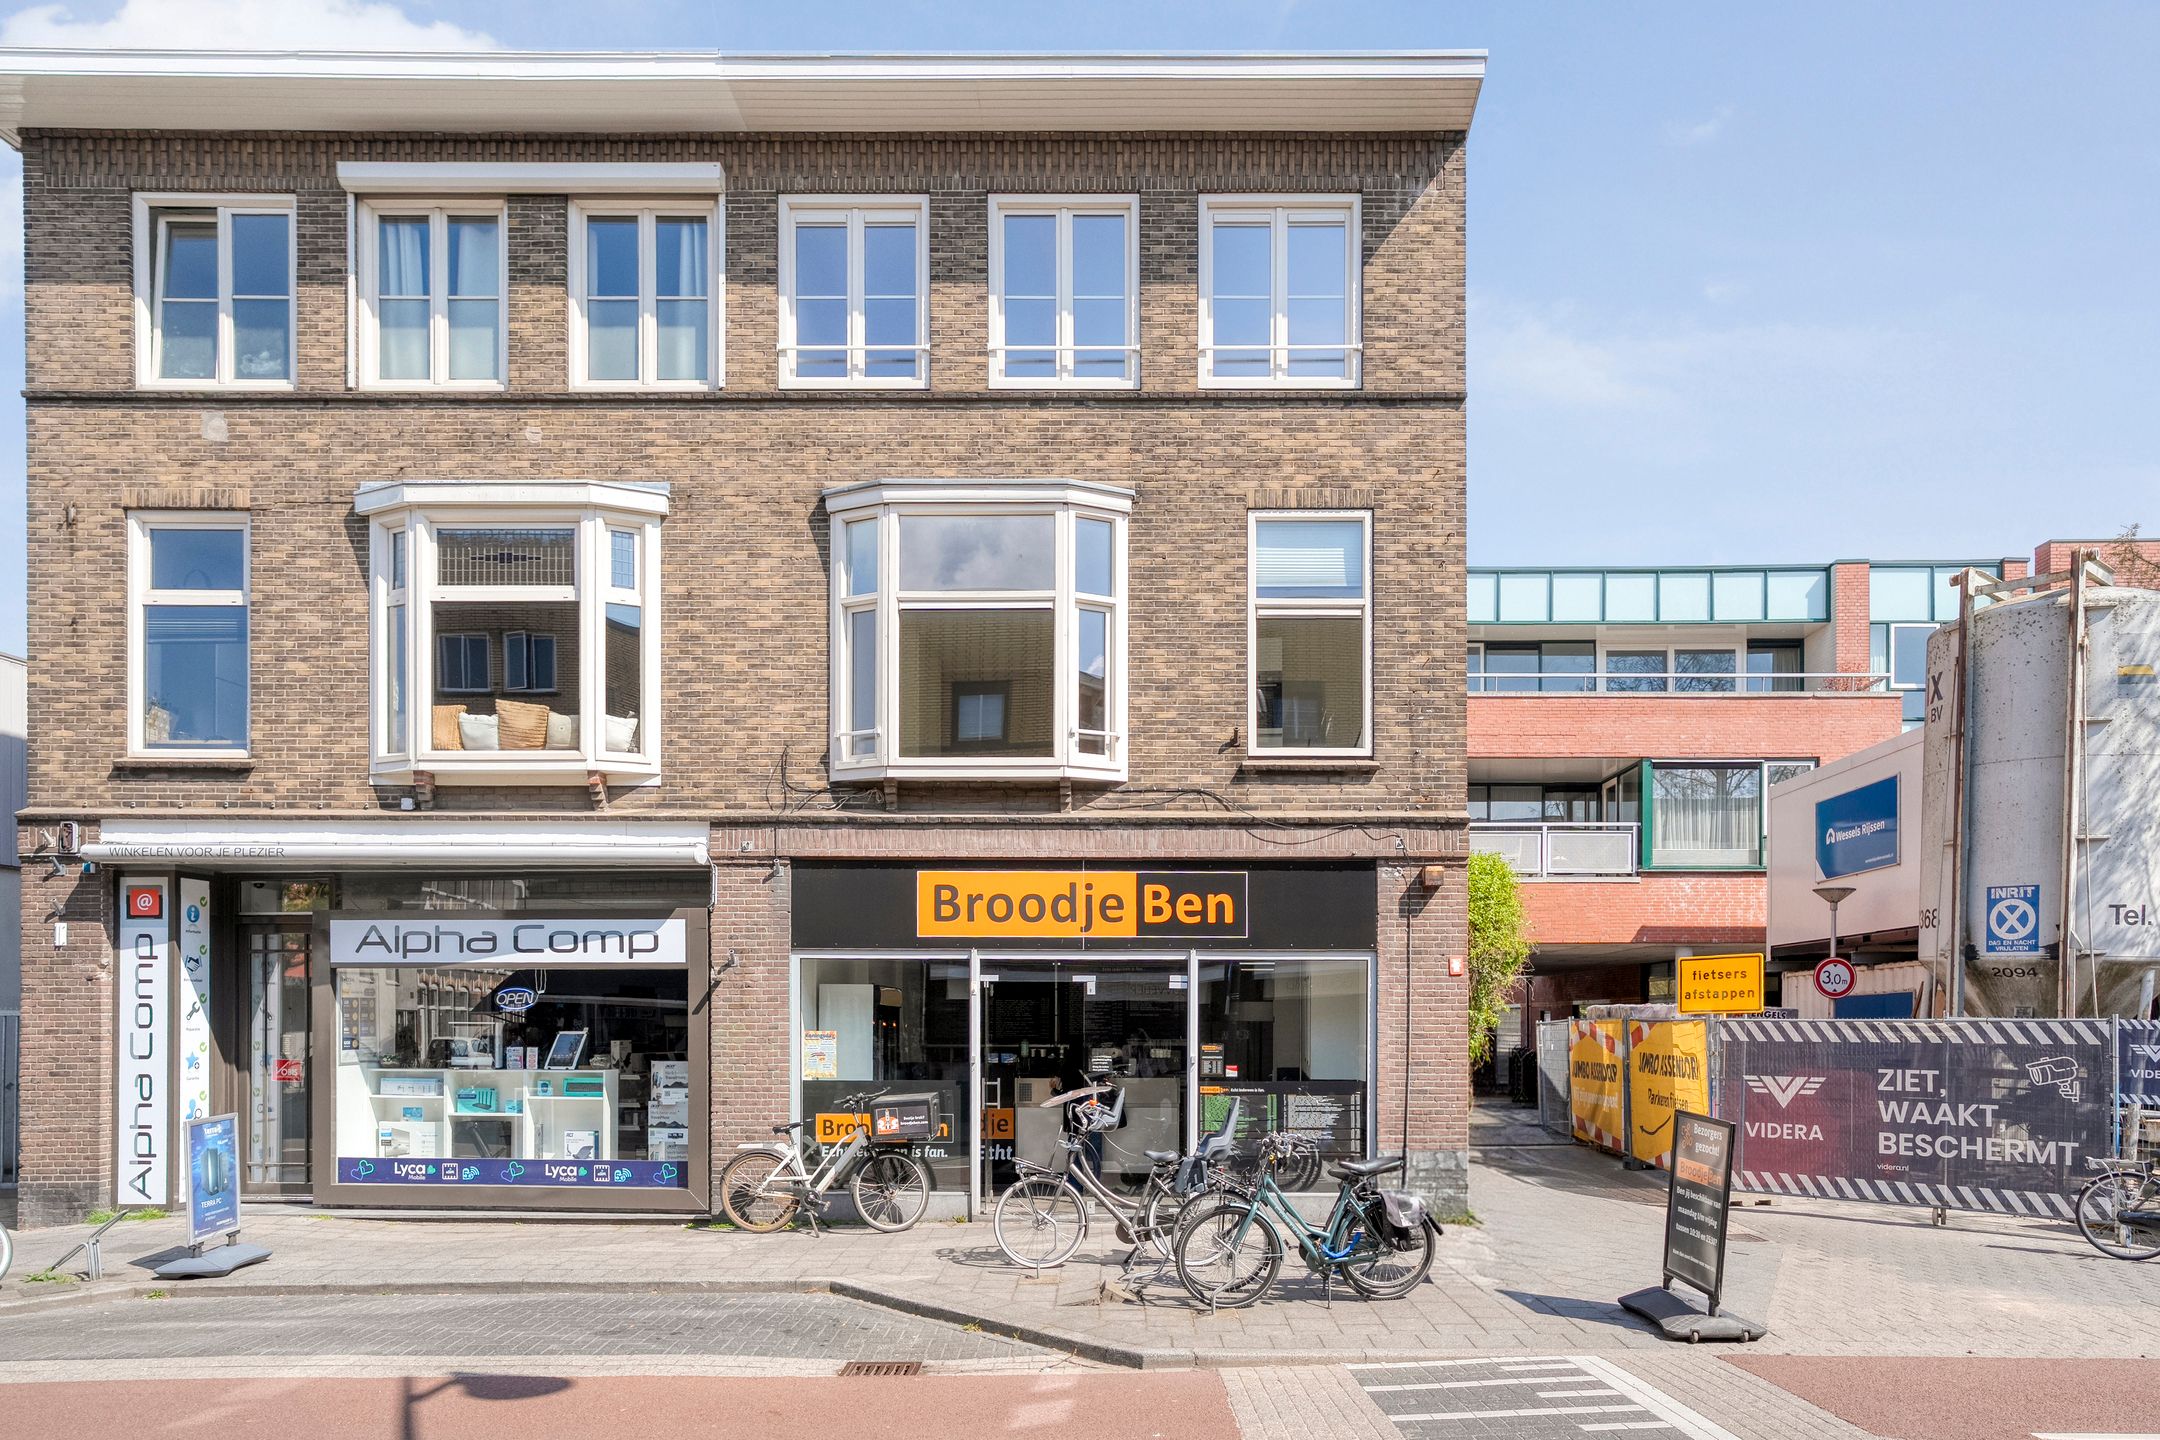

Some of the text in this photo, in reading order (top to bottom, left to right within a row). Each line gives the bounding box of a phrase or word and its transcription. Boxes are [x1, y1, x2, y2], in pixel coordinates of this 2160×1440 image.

[1836, 820, 1885, 841] Wessels Rijssen
[109, 847, 286, 857] WINKELEN VOOR JE PLEZIER
[1991, 886, 2035, 899] INRIT
[933, 882, 1234, 933] Broodje Ben
[2108, 904, 2152, 926] Tel.
[355, 924, 659, 959] Alpha Comp
[1692, 969, 1748, 981] fietsers
[1991, 967, 2038, 978] 2094
[496, 992, 534, 1005] OPEN
[1684, 989, 1755, 1001] afstappen
[128, 933, 158, 1200] Alpha Comp
[1877, 1069, 1947, 1098] ZIET,
[1648, 1088, 1670, 1108] Parkeren
[1877, 1100, 2005, 1133] WAAKT,
[1694, 1123, 1722, 1141] Bezorgers
[1745, 1121, 1824, 1141] VIDERA
[912, 1145, 922, 1158] is
[924, 1145, 948, 1158] fan.
[1695, 1142, 1720, 1157] gezocht!
[1878, 1132, 2080, 1166] BESCHERMT
[394, 1162, 426, 1176] Lyca
[545, 1164, 577, 1178] Lyca
[1676, 1185, 1686, 1196] Ben
[201, 1198, 216, 1208] TERRA
